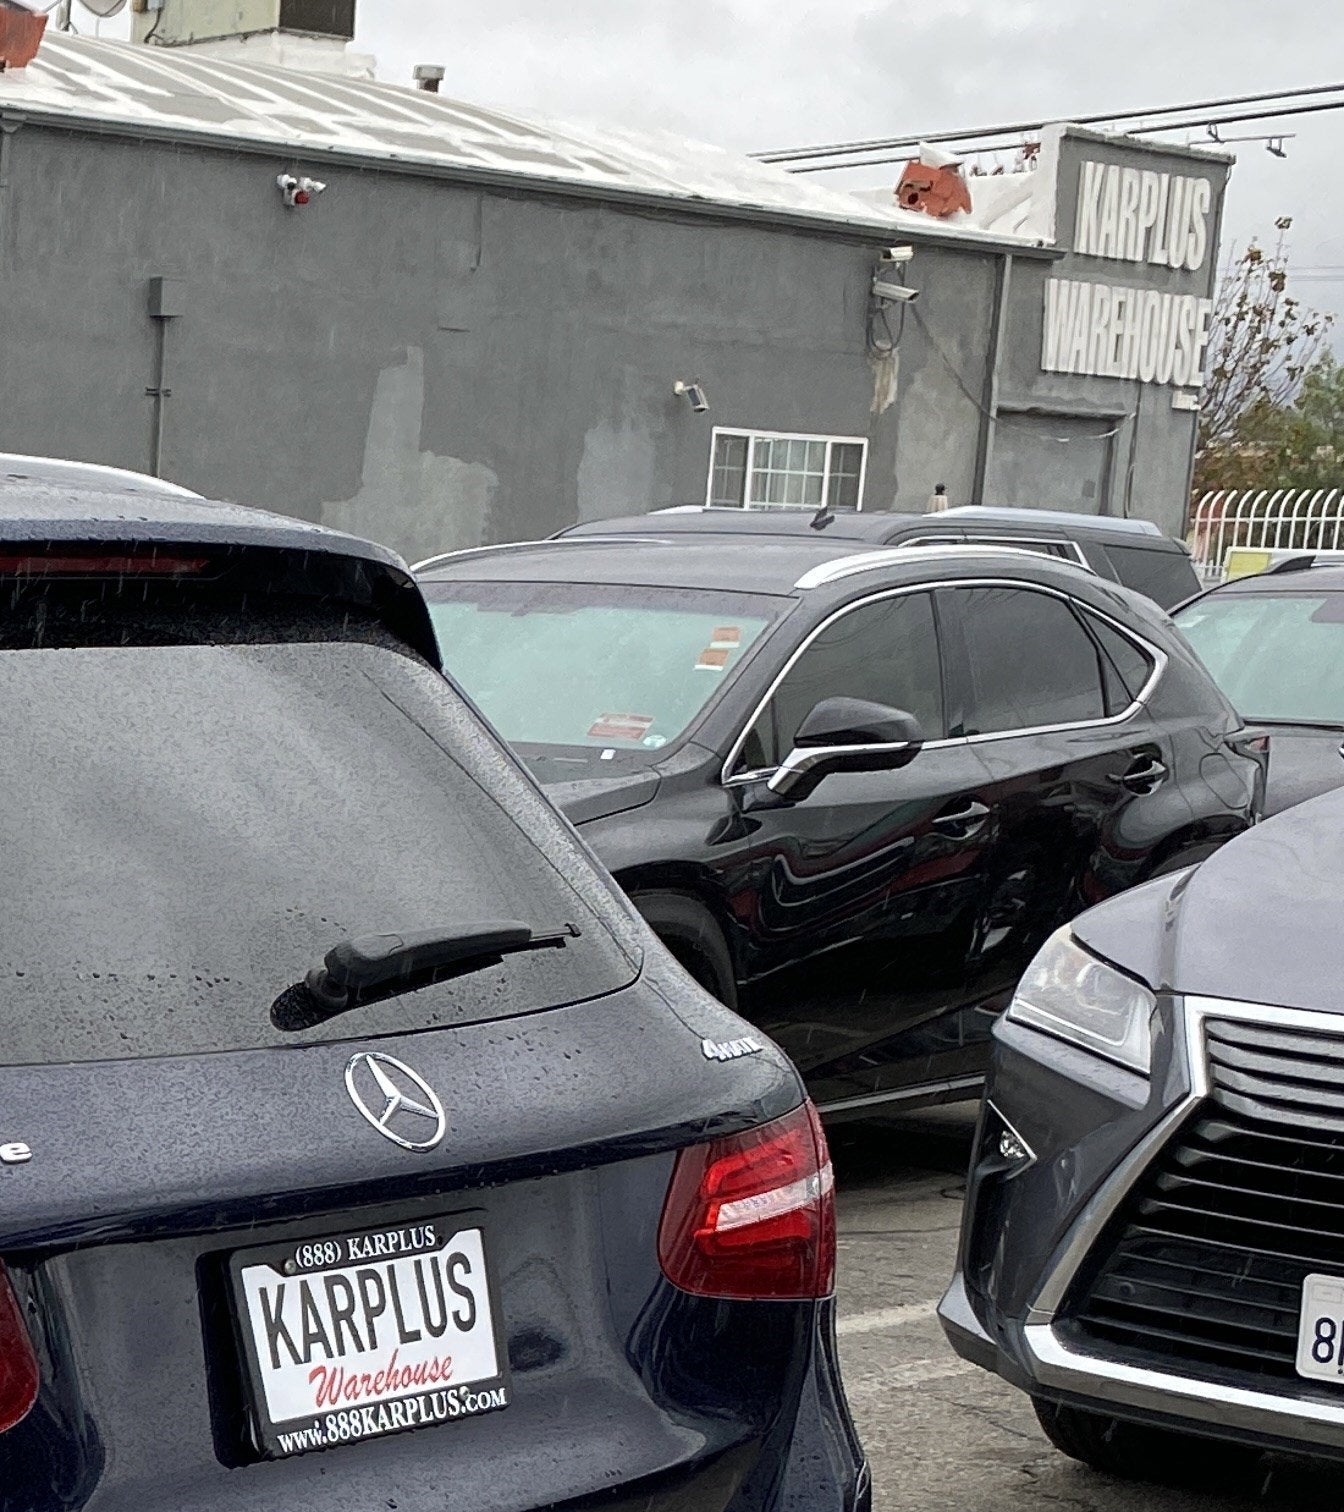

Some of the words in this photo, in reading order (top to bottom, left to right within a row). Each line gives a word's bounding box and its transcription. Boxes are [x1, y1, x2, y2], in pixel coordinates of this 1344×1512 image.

[1074, 160, 1211, 271] KARPLUS
[1041, 278, 1211, 386] WAREHOUSE
[295, 1241, 342, 1268] (888)
[347, 1225, 436, 1261] KARPLUS
[259, 1251, 477, 1370] KARPLUS
[1312, 1317, 1344, 1367] 8
[308, 1348, 453, 1408] Warehouse
